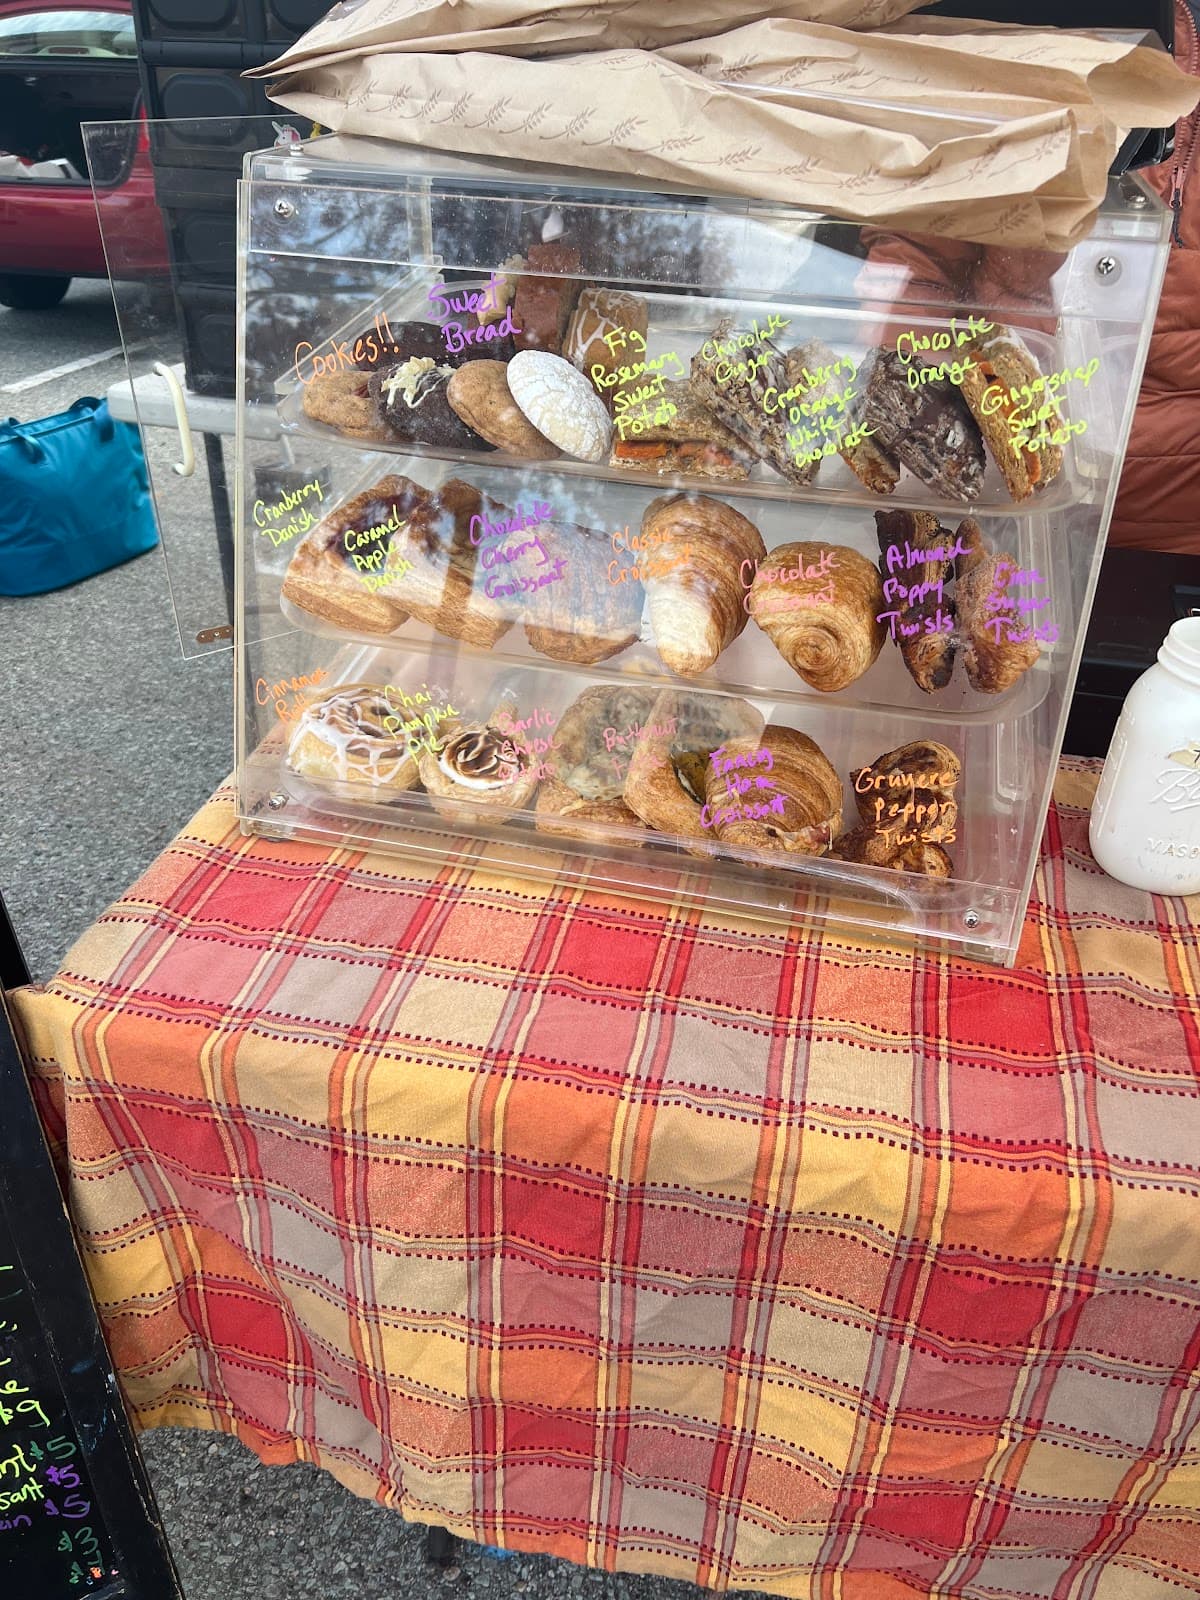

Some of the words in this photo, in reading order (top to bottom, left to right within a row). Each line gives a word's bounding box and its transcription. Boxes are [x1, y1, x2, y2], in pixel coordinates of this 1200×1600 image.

[427, 272, 506, 320] Sweet
[295, 311, 400, 385] Cookies!!
[441, 306, 522, 352] Bread
[604, 326, 647, 356] Fig
[702, 314, 792, 361] Chocolate
[897, 315, 994, 364] Chocolate
[591, 352, 685, 392] Rosemary
[612, 374, 667, 413] Sweet
[253, 480, 324, 527] Cranberry
[262, 507, 319, 547] Danish
[344, 504, 407, 551] Caramel
[352, 540, 399, 572] Apple
[482, 536, 549, 570] Cherry
[886, 536, 973, 574] Almond
[360, 556, 414, 593] Danish
[882, 577, 943, 607] Poppy
[384, 683, 431, 712] Chai
[383, 703, 460, 739] Pumpkin
[875, 797, 955, 824] Pepper
[876, 825, 958, 849] Twists
[45, 1463, 80, 1489] $5
